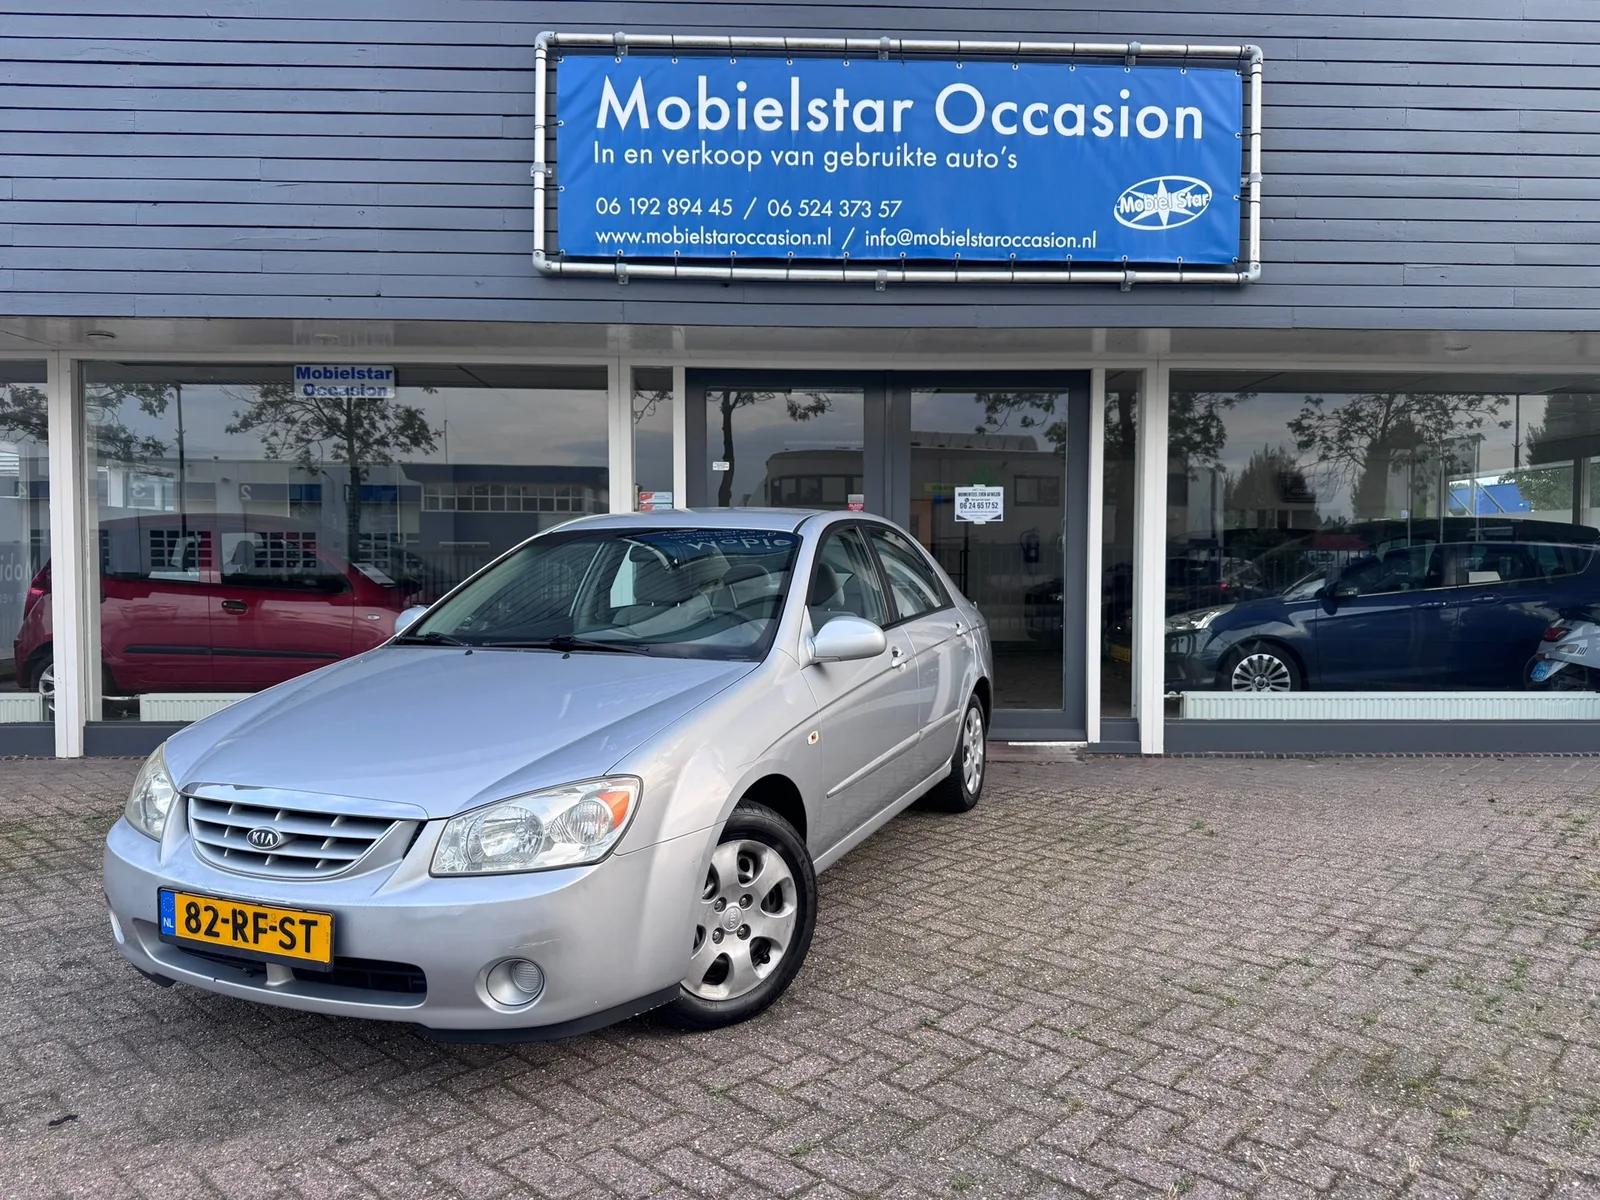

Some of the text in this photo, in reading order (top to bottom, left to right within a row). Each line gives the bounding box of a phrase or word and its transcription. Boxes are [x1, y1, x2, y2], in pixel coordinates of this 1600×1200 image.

[596, 75, 1203, 139] Mobielstar Occasion
[594, 140, 1018, 173] In en verkoop van gebruikte auto's
[595, 197, 903, 220] 06 192 894 45 / 06 524 373 57
[1120, 191, 1209, 214] Mobiel Star
[595, 226, 1097, 250] www.mobielstaroccasion.nl / info@mobielstaroccasion.nl
[296, 366, 393, 380] Mobielstar
[303, 383, 388, 397] Occasion
[252, 831, 273, 845] KIA
[163, 917, 174, 928] NL
[184, 901, 318, 954] 82-RF-ST
